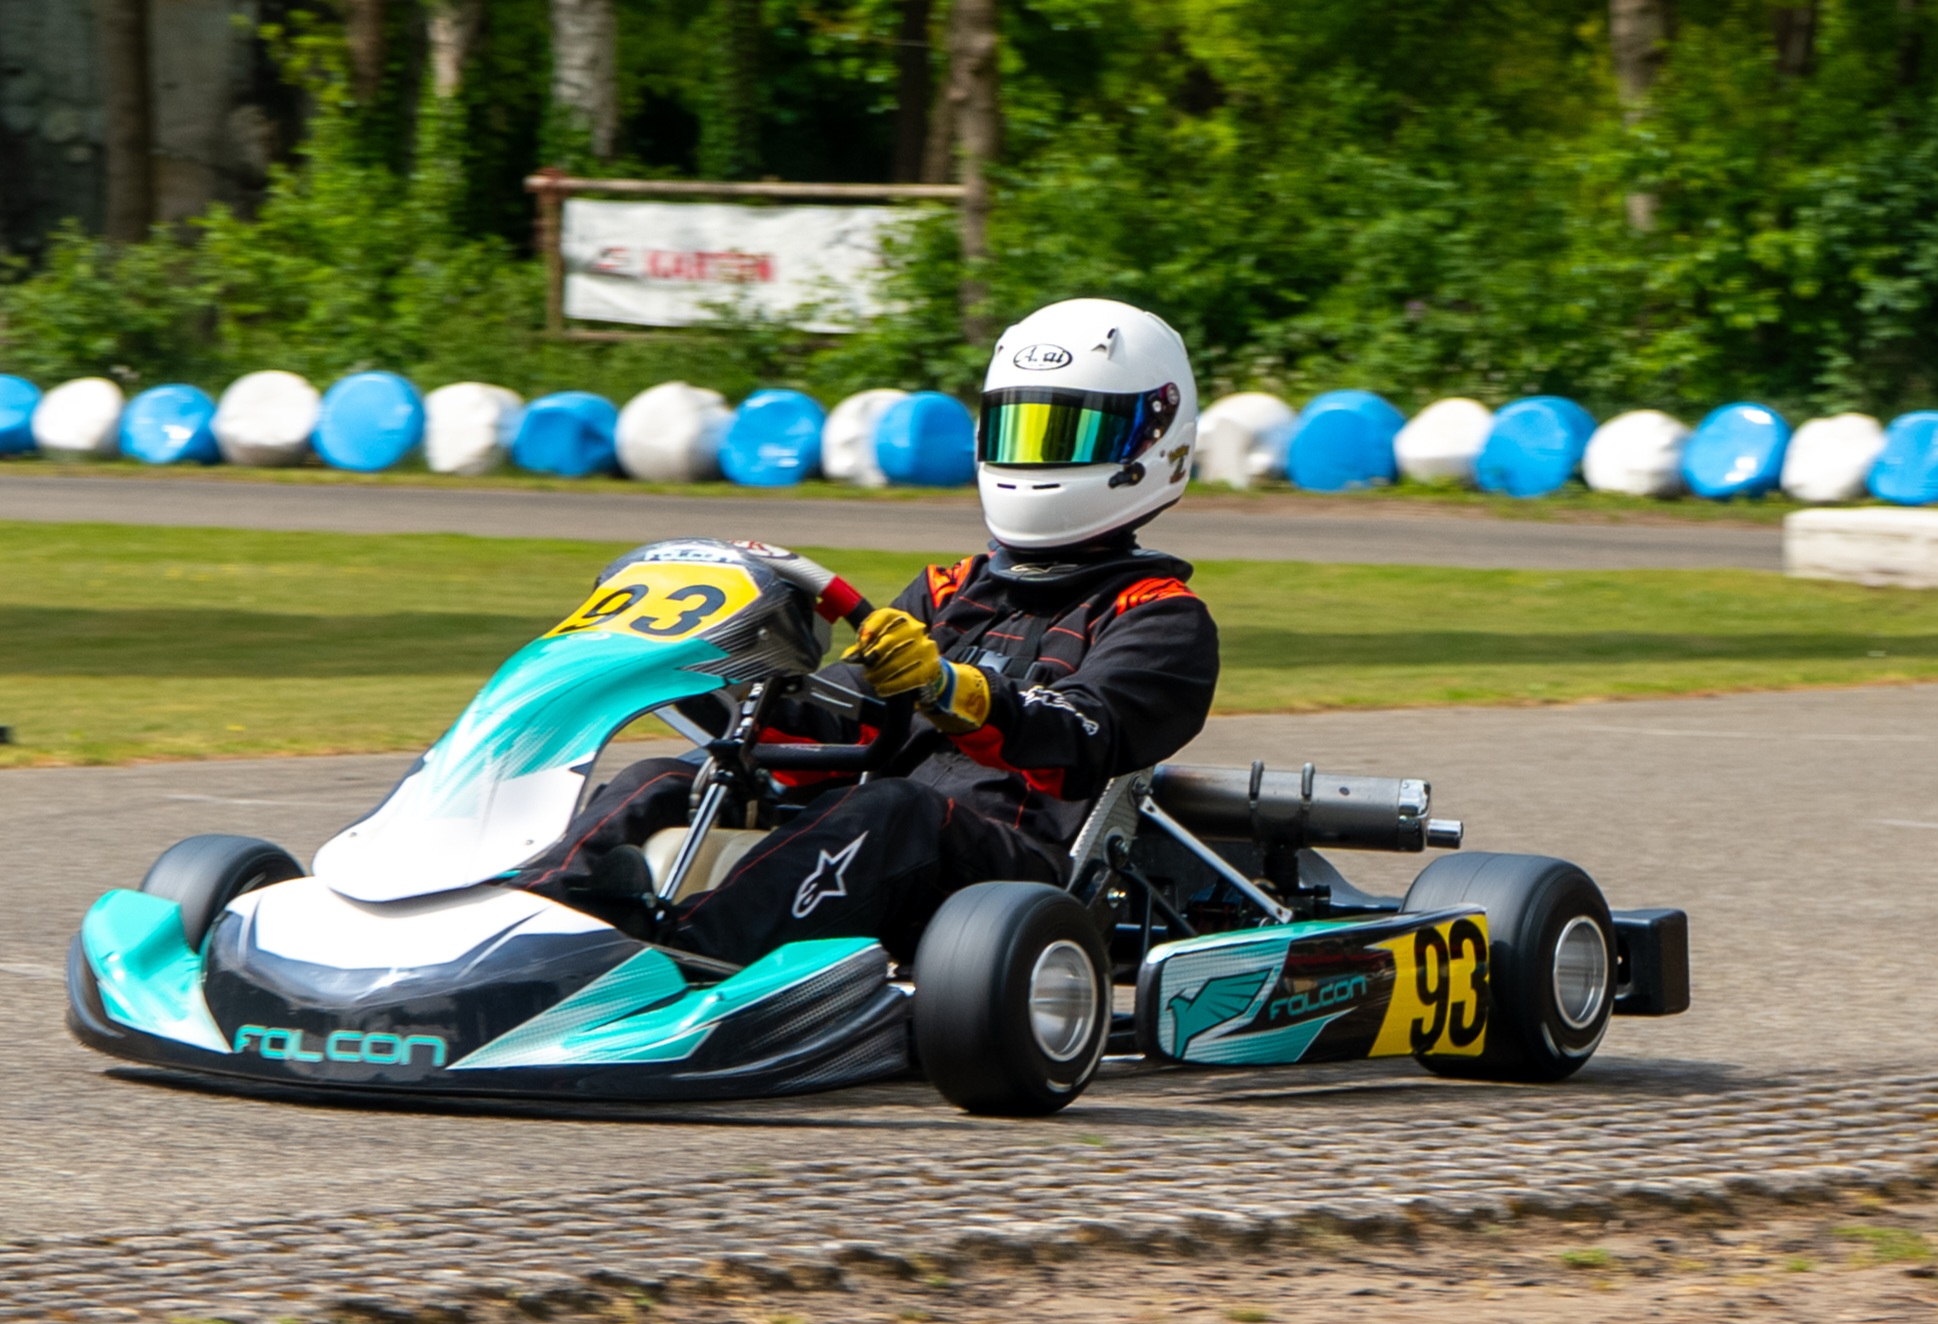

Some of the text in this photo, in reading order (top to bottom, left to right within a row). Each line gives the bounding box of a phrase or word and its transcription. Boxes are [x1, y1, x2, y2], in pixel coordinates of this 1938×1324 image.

[1015, 345, 1065, 363] Aai
[558, 583, 727, 637] 93
[1410, 919, 1488, 1052] 93
